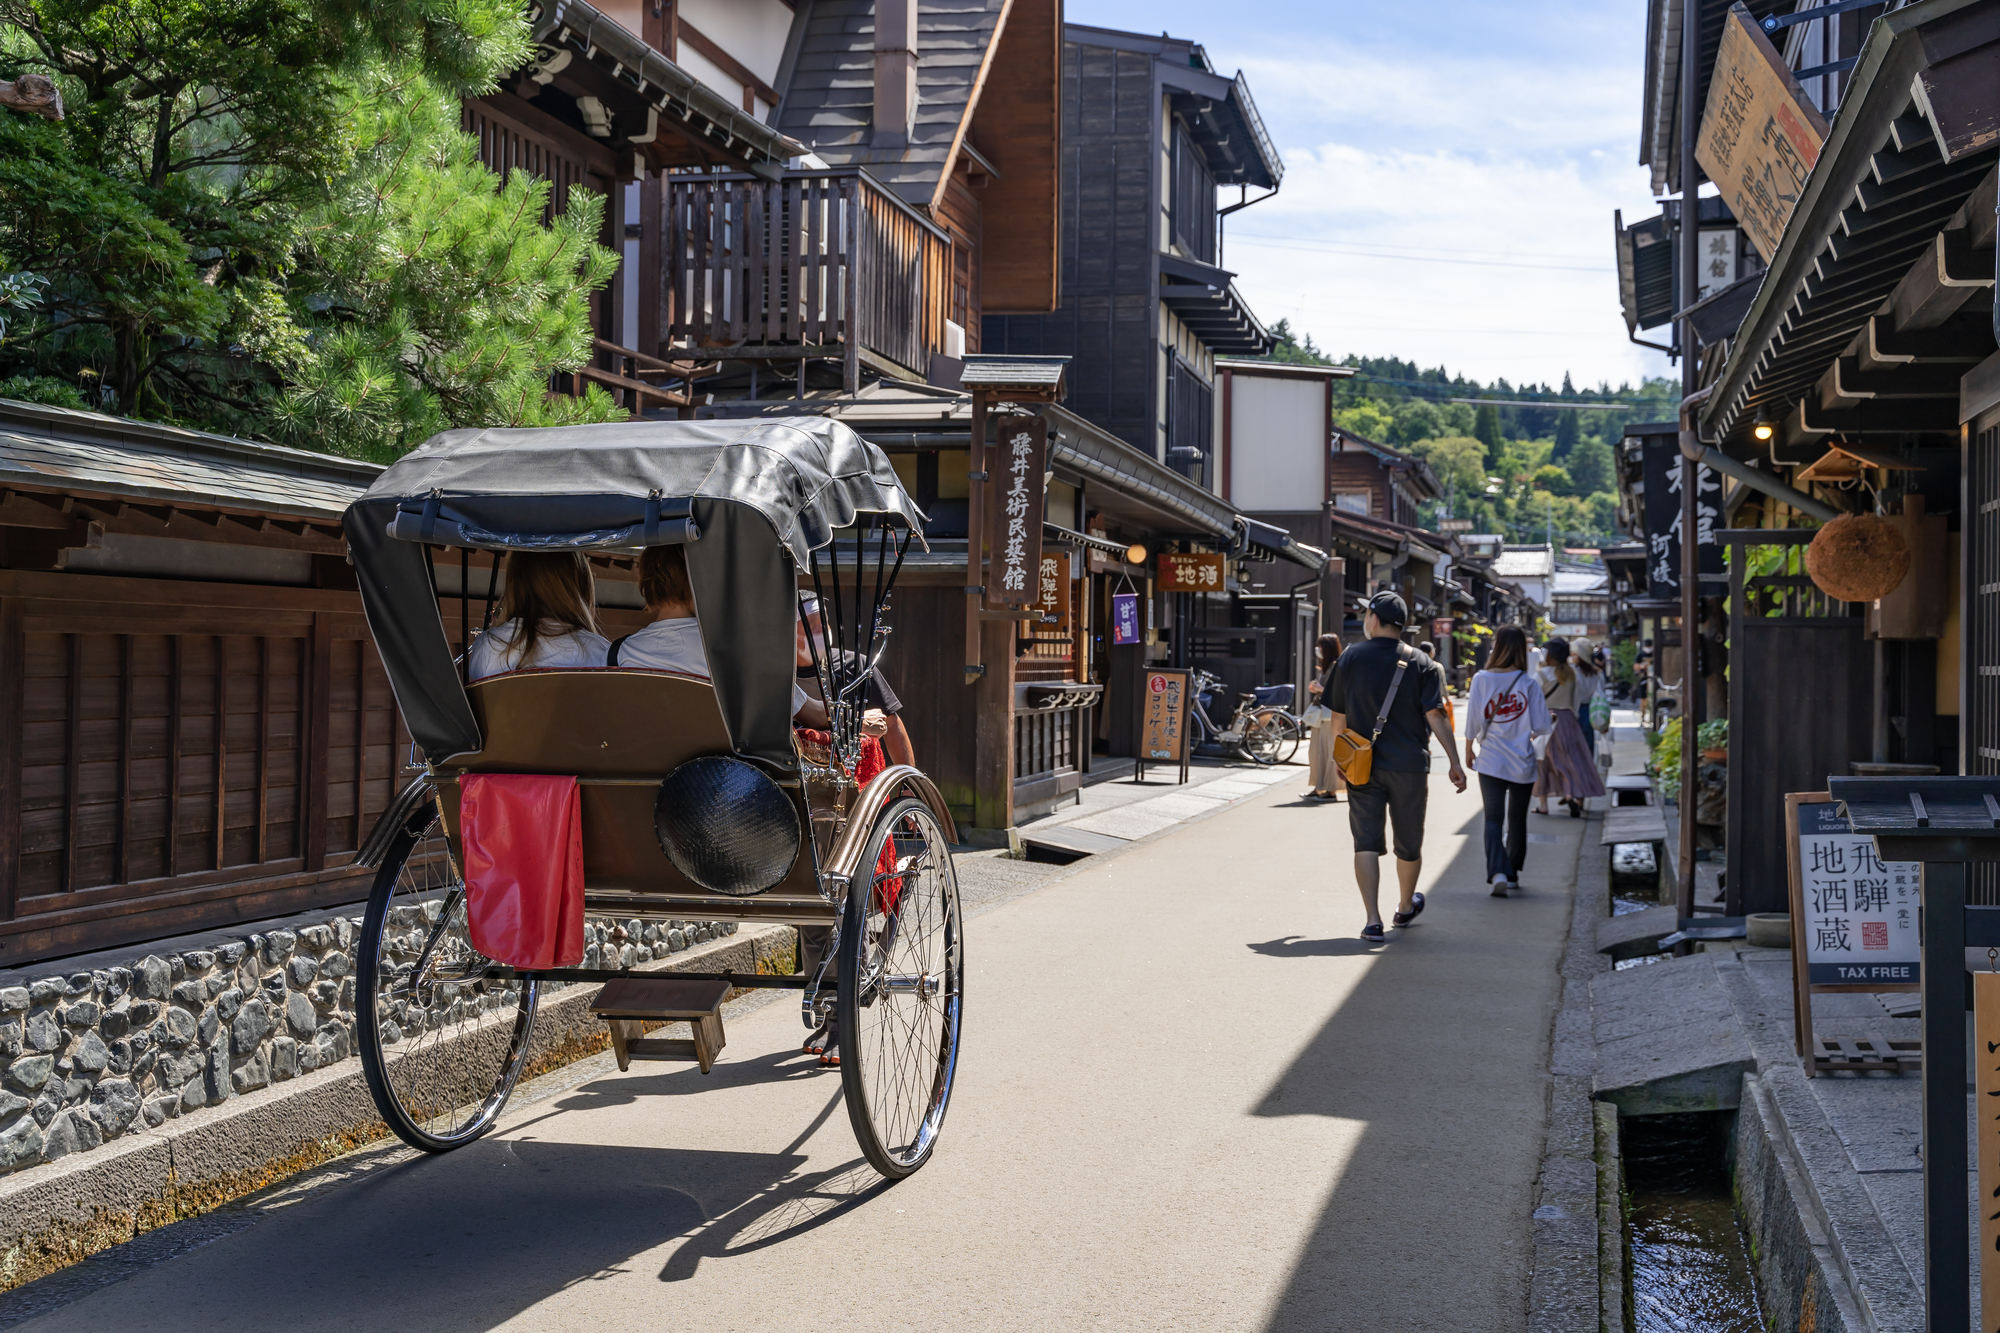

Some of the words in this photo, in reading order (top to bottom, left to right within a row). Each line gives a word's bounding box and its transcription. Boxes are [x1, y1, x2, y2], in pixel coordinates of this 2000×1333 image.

[1003, 432, 1033, 590] 藤井美術民藝館
[1041, 558, 1059, 611] 飛騨牛
[1176, 565, 1218, 586] 地酒
[1120, 602, 1132, 638] 甘酒
[1809, 840, 1852, 952] 地酒蔵
[1850, 841, 1890, 913] 飛騨
[1838, 967, 1868, 978] TAX
[1871, 966, 1910, 978] FREE
